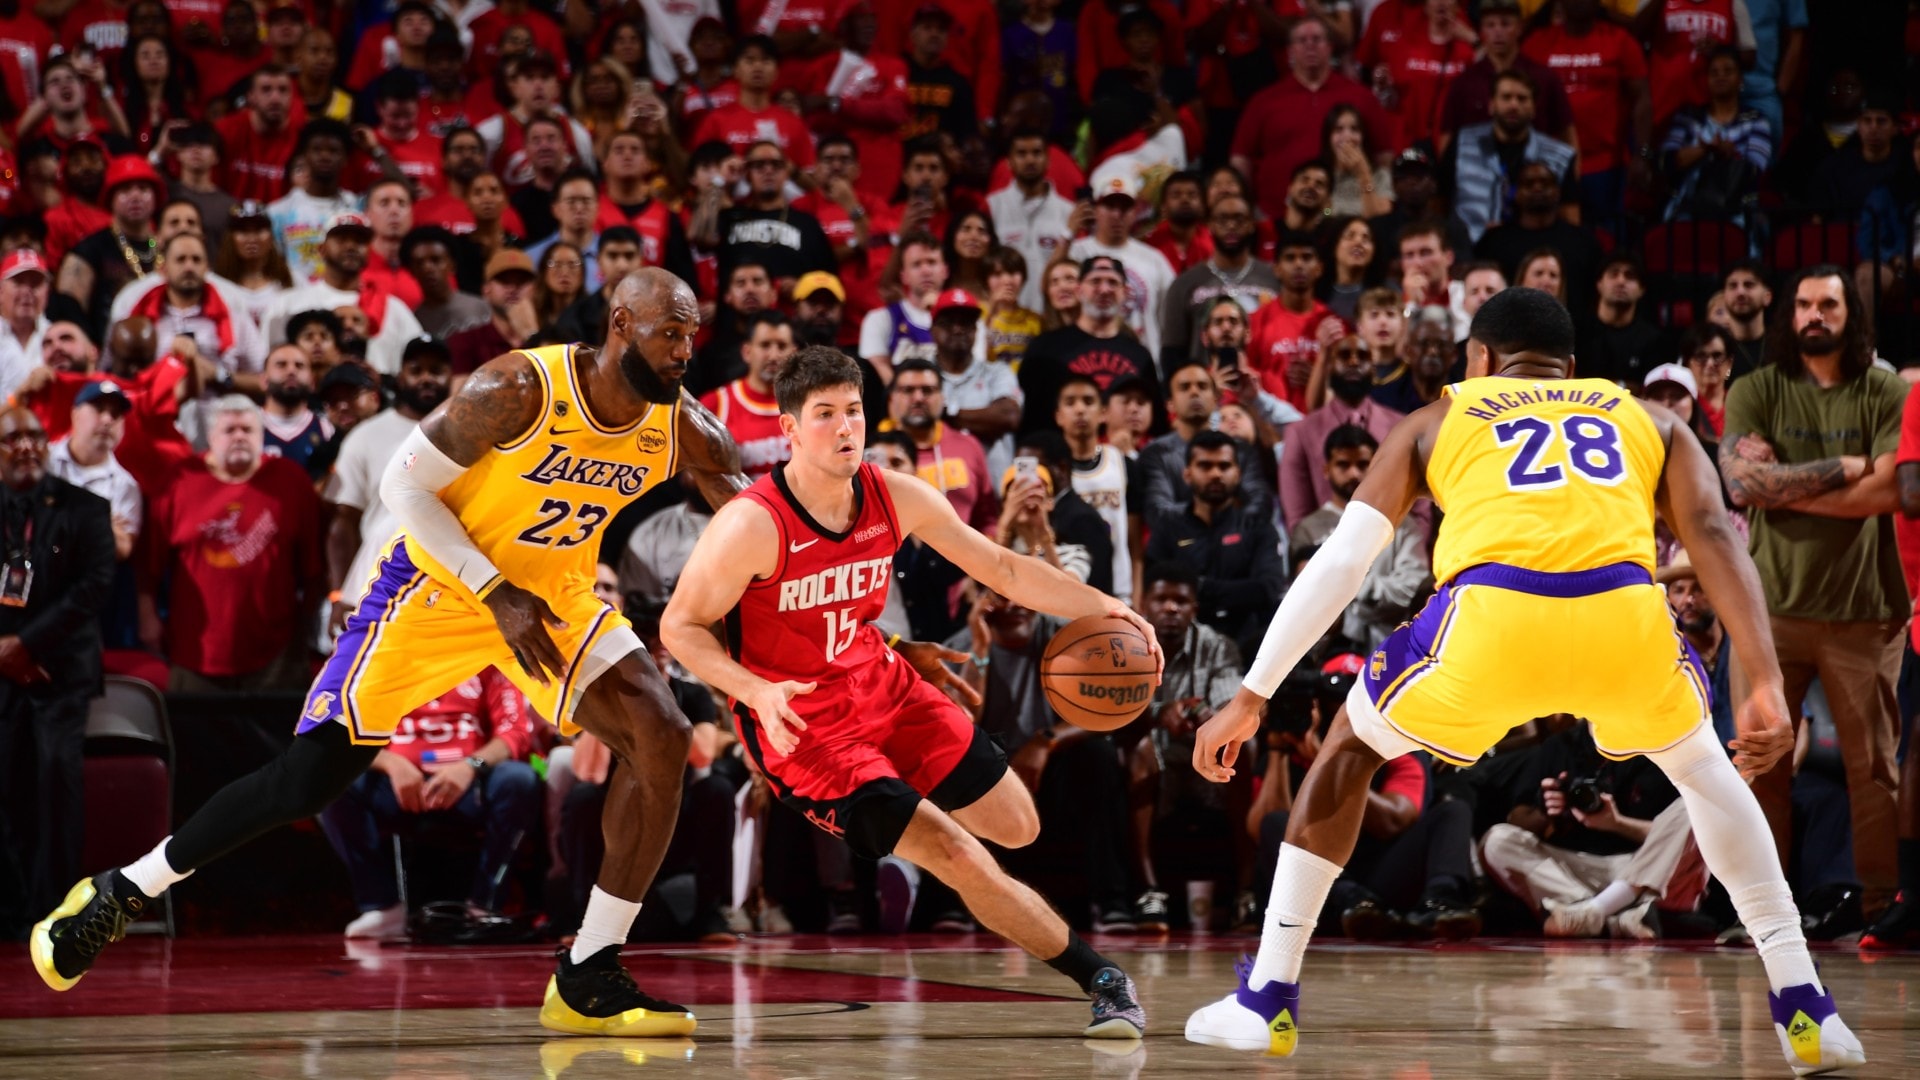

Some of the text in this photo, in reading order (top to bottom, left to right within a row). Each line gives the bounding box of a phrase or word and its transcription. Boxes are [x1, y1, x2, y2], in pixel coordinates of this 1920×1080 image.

[1067, 348, 1138, 375] ROCKETS
[1464, 389, 1622, 420] HACHIMURA
[640, 435, 665, 451] bibigo
[1492, 413, 1628, 491] 28
[521, 443, 650, 496] LAKERS
[514, 497, 609, 548] 23
[854, 522, 888, 539] MEMORIAL
[855, 528, 889, 544] HERMANN
[778, 556, 893, 612] ROCKETS
[823, 606, 858, 663] 15
[1078, 681, 1150, 706] Wilson
[390, 713, 485, 744] USA
